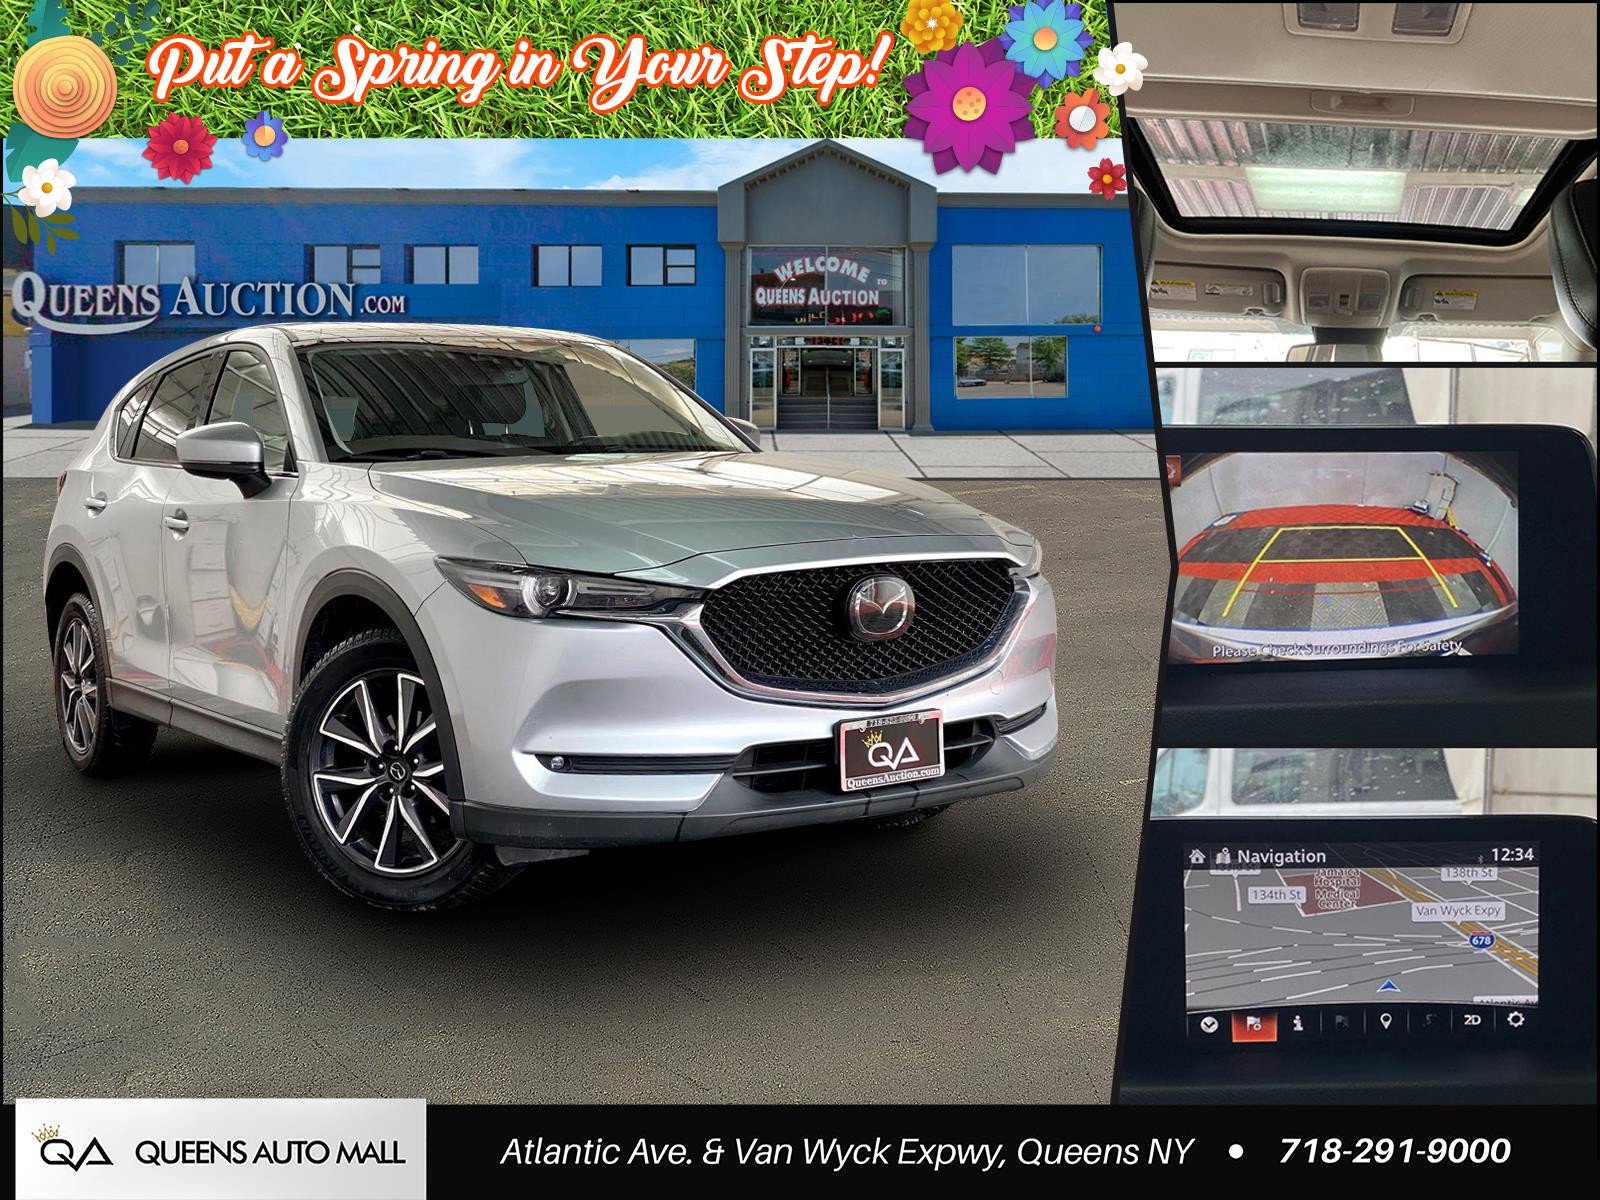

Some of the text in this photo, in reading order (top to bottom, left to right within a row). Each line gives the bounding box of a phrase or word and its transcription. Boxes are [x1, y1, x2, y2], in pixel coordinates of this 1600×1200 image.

[773, 255, 871, 284] WELCOME
[876, 278, 888, 286] TO
[12, 270, 161, 334] QUEENS
[169, 276, 356, 317] AUCTION
[755, 287, 880, 307] QUEENS AUCTION
[1212, 639, 1463, 658] Please Check Surroundings For Safety
[868, 736, 920, 770] QA
[847, 766, 940, 790] QueensAuction.com
[1238, 848, 1326, 867] Navigation
[1491, 847, 1535, 862] 12:34
[1314, 868, 1361, 878] Jamaica
[1445, 867, 1493, 878] 138th St
[1314, 876, 1361, 888] Hospital
[1253, 889, 1302, 900] 134th St
[1315, 888, 1360, 900] Medical
[1317, 899, 1358, 910] Center
[1416, 905, 1501, 919] Van Wyck Expy
[1472, 937, 1491, 946] 678
[1463, 1014, 1482, 1026] 2D
